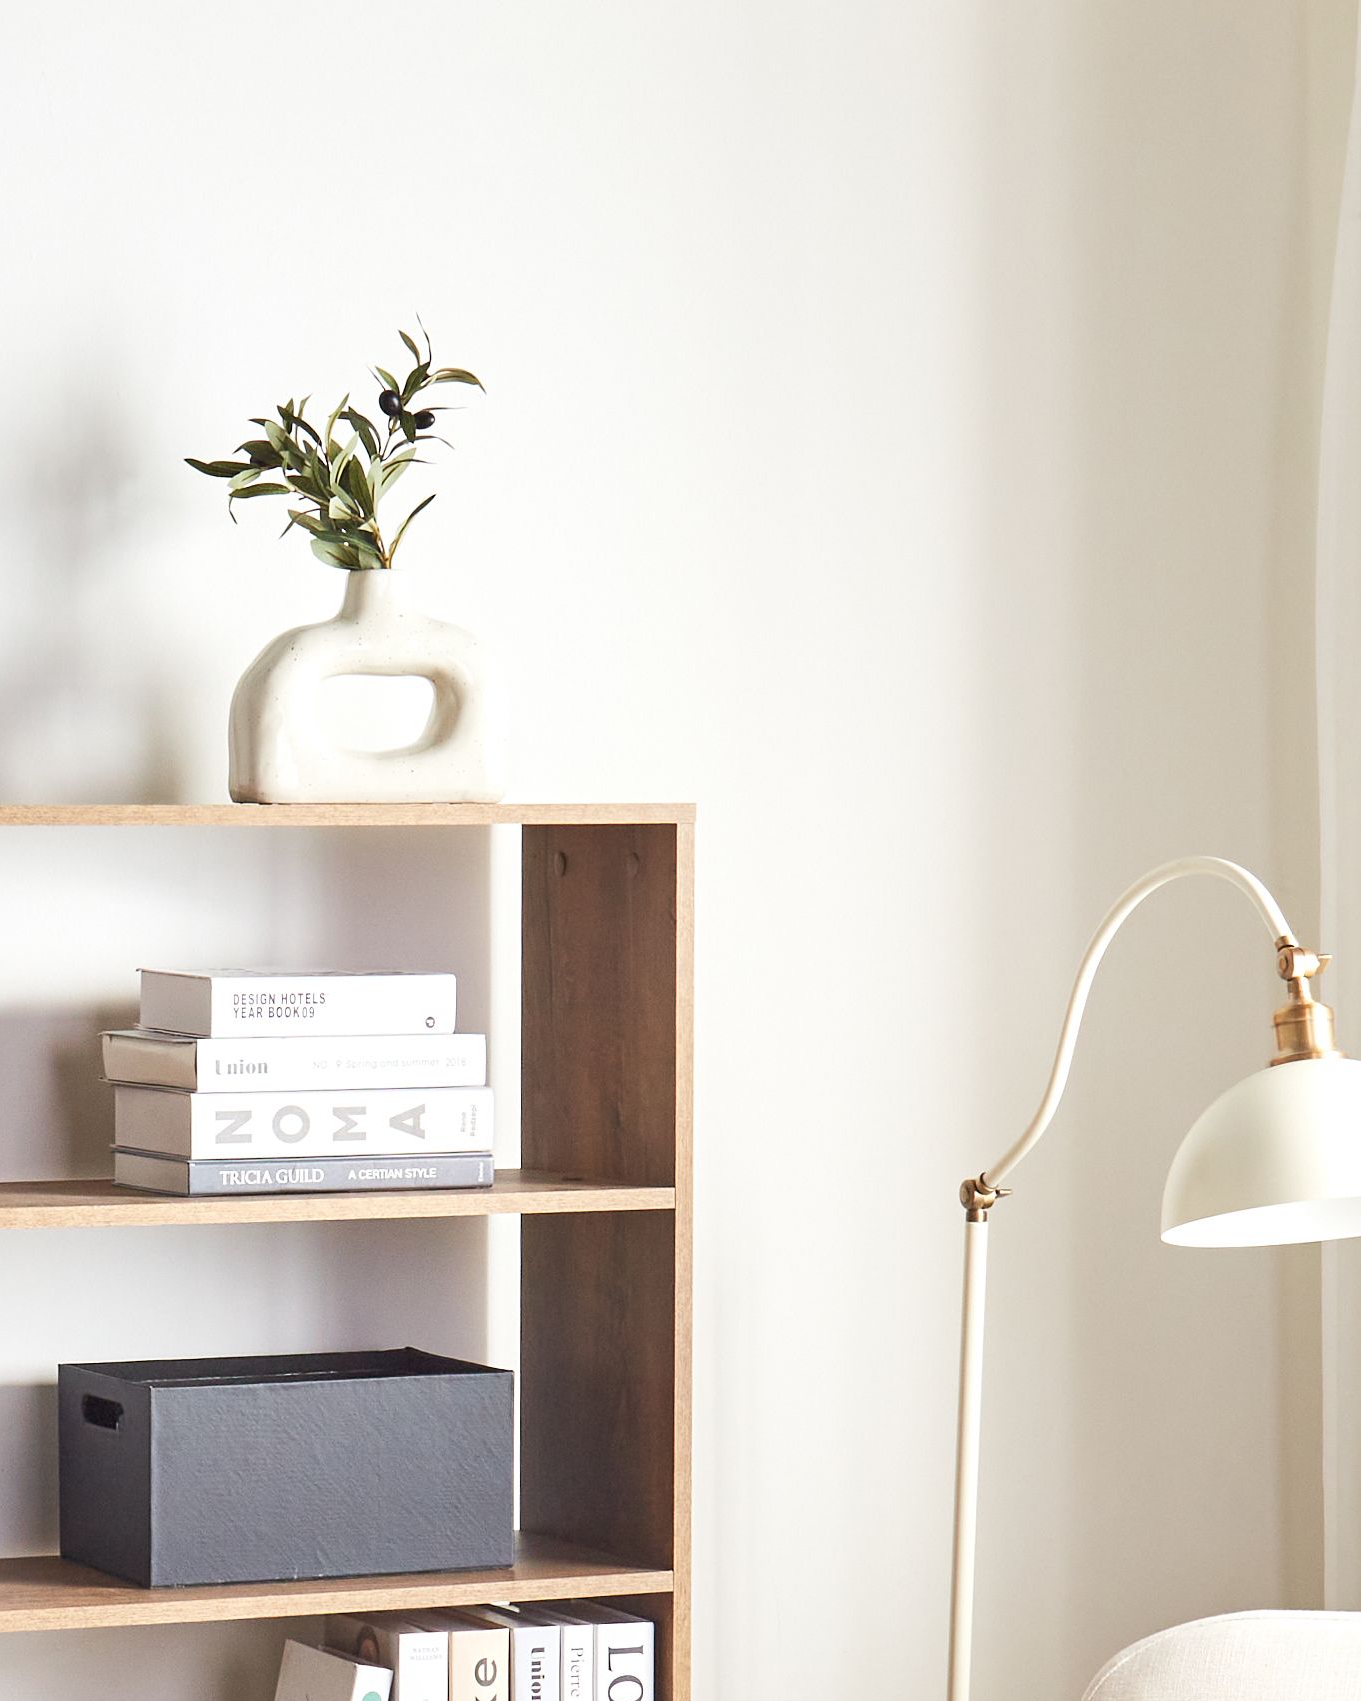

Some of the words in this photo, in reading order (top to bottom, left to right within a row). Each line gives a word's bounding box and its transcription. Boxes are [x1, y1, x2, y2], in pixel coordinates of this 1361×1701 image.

[232, 992, 277, 1006] DESIGN
[280, 991, 327, 1005] HOTELS
[232, 1006, 264, 1019] YEAR
[214, 1103, 426, 1145] NOMA
[219, 1170, 274, 1186] TRICIA
[275, 1168, 325, 1185] GUILD
[347, 1169, 357, 1181] A
[358, 1167, 403, 1181] CERTIAN
[403, 1166, 437, 1180] STYLE
[570, 1646, 585, 1698] Pierre
